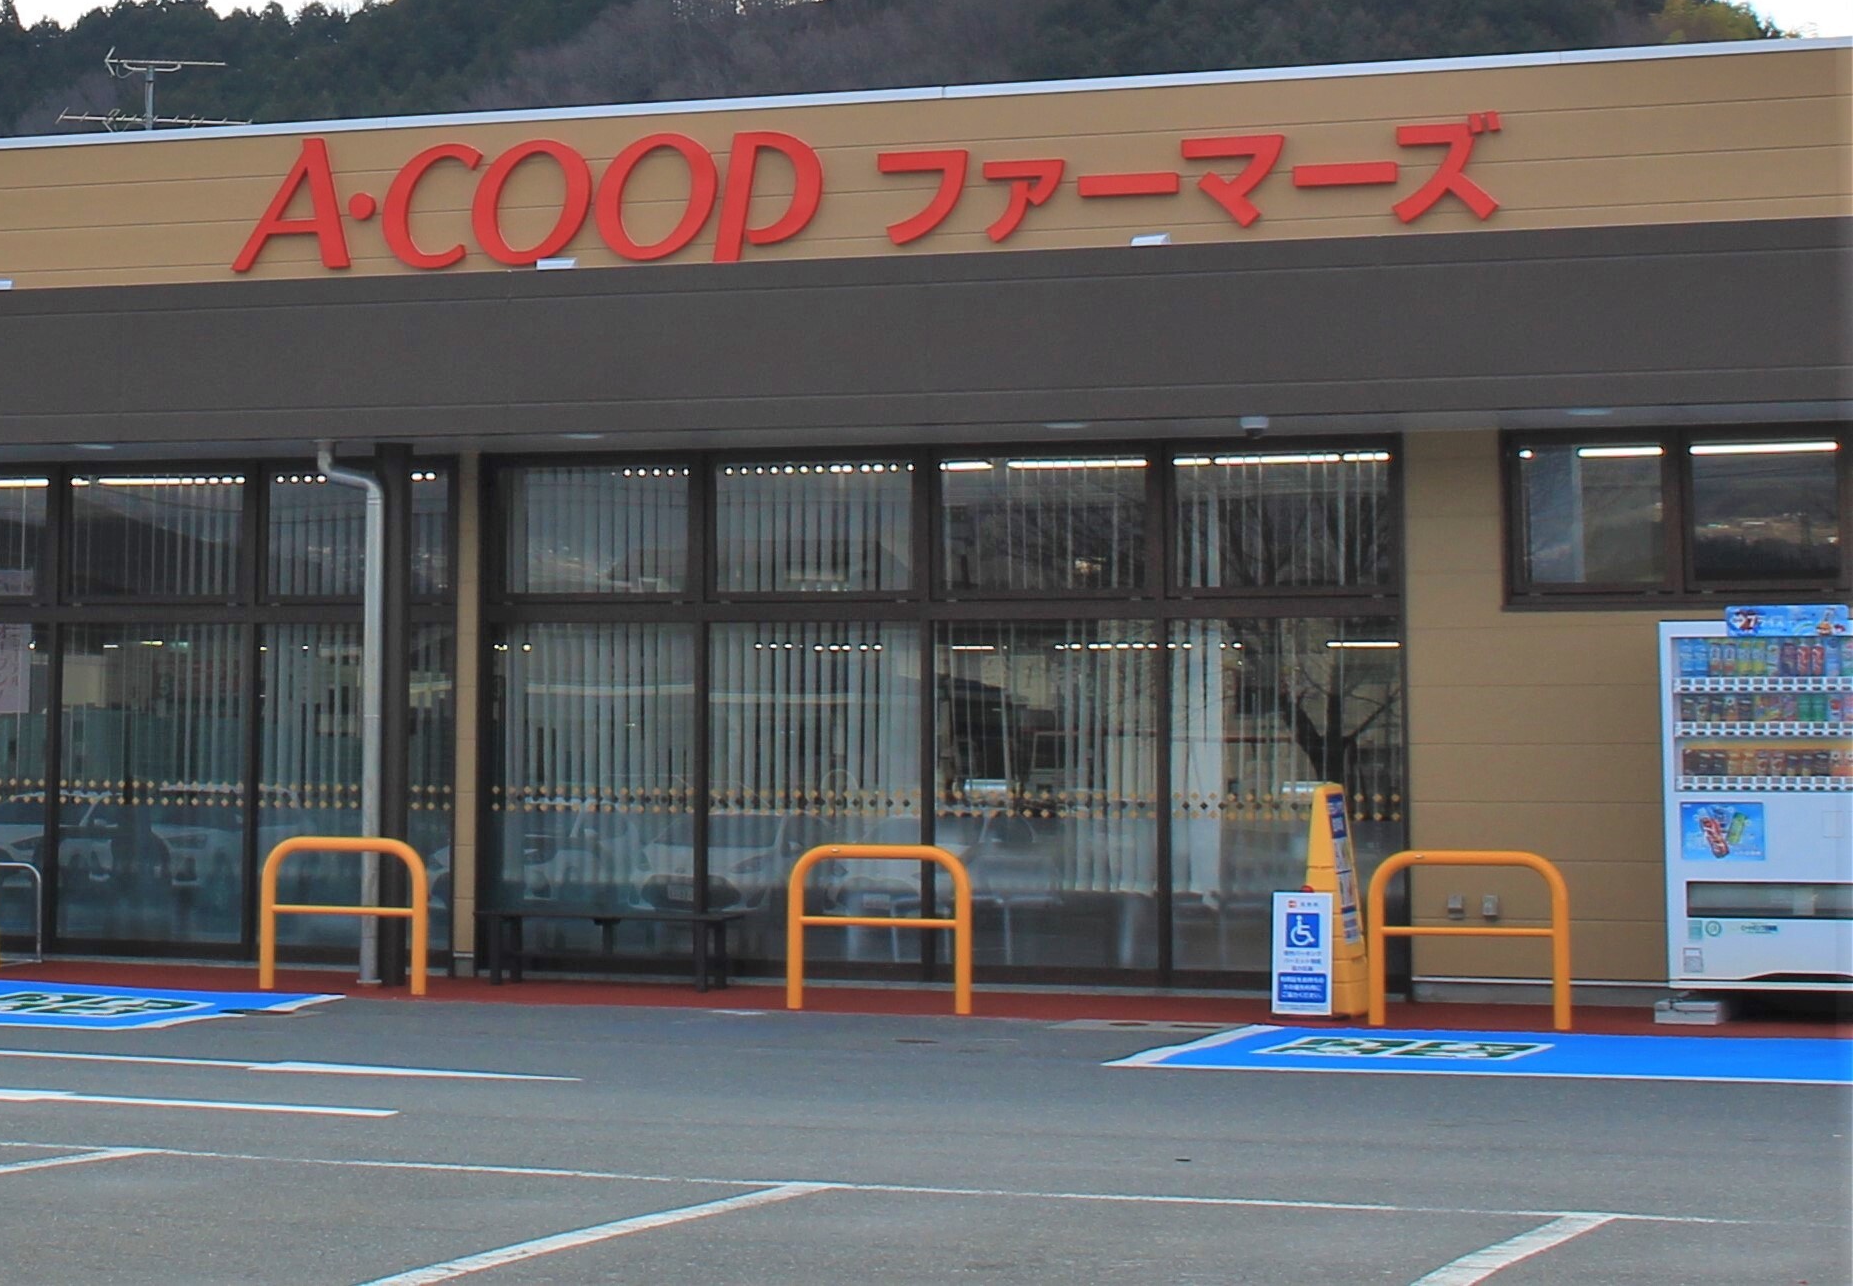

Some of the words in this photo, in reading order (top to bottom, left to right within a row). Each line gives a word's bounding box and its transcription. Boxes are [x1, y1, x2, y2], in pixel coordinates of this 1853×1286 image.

[876, 111, 1503, 246] ファーマーズ
